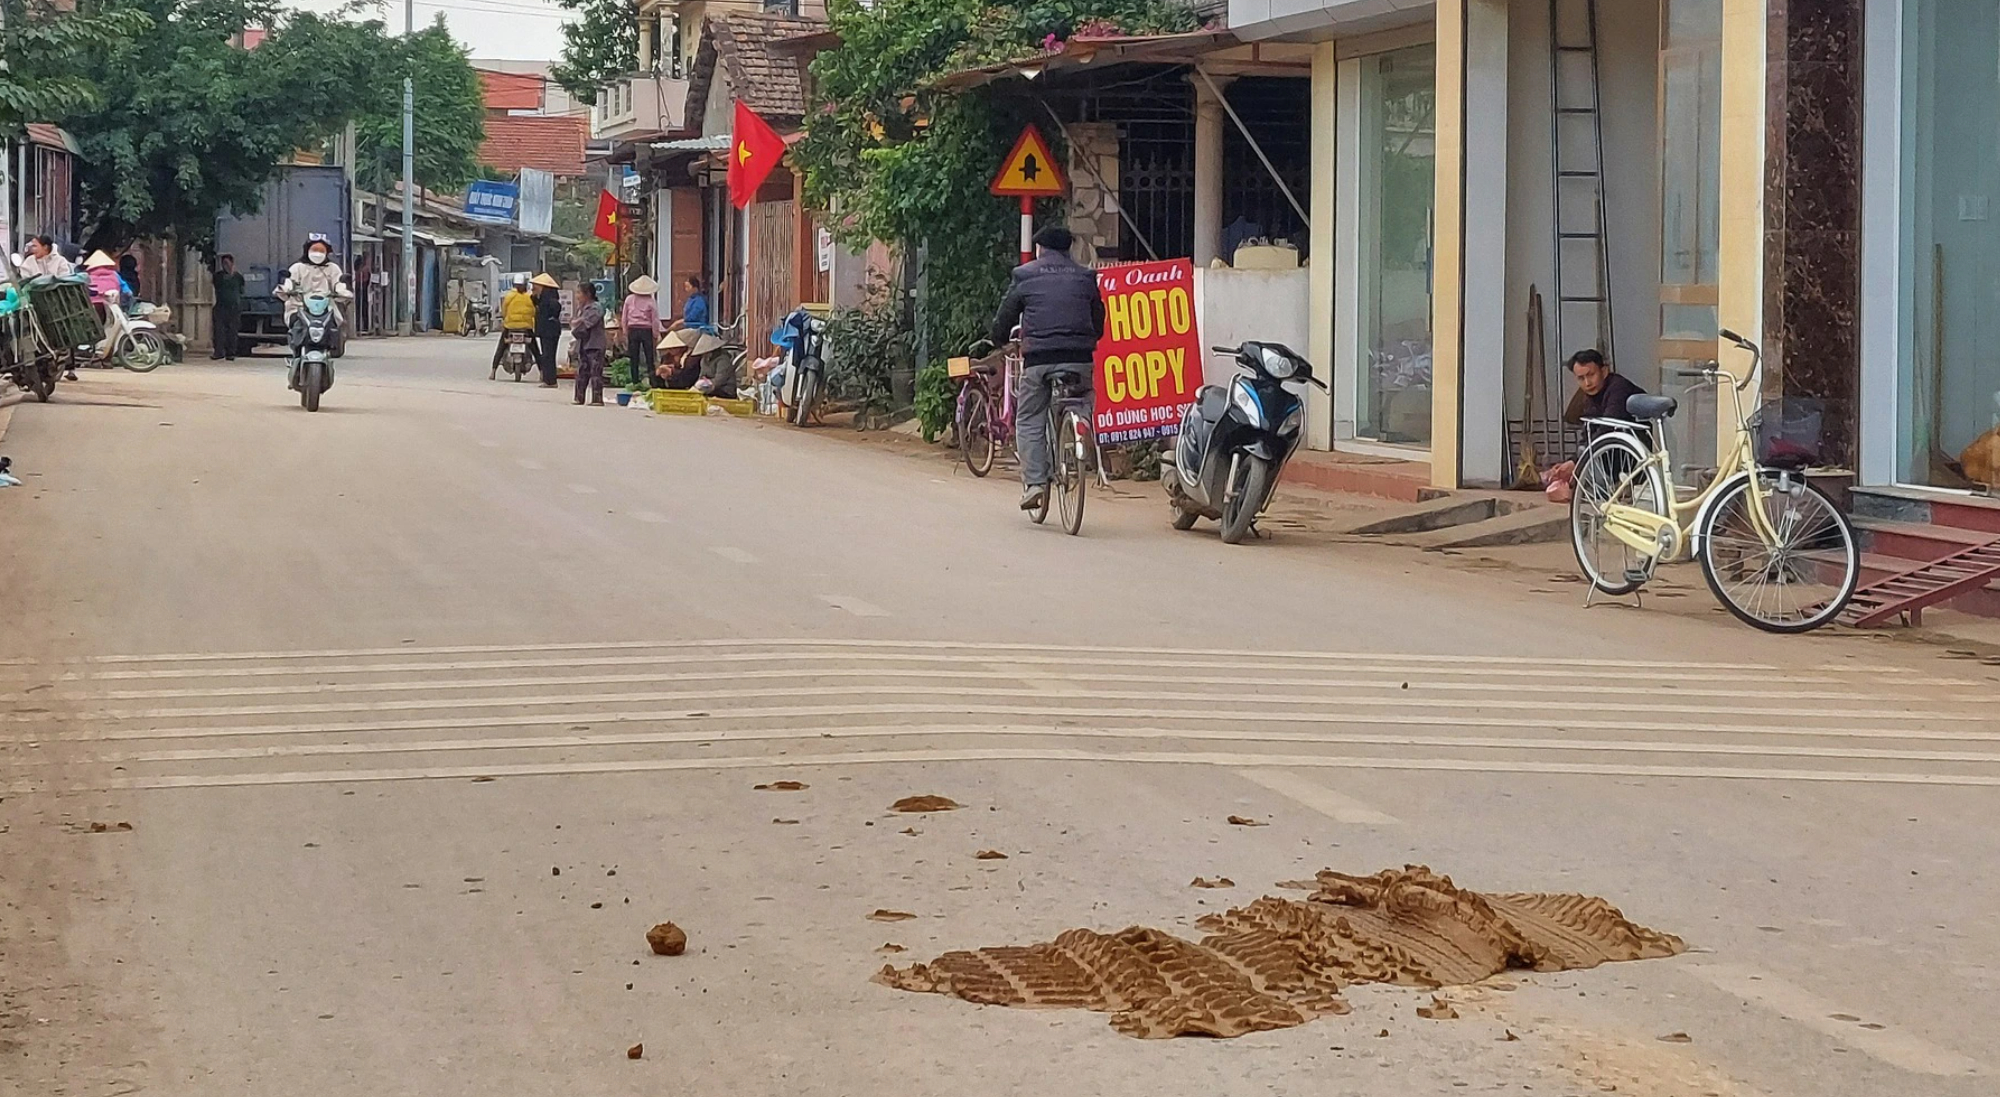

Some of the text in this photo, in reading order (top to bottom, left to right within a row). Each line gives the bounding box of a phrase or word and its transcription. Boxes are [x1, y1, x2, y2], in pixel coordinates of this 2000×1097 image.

[1125, 264, 1183, 286] Oanh
[1104, 287, 1190, 342] HOTO
[1104, 347, 1185, 403] COPY
[1116, 407, 1148, 426] DÙNG
[1150, 405, 1174, 424] HỌC
